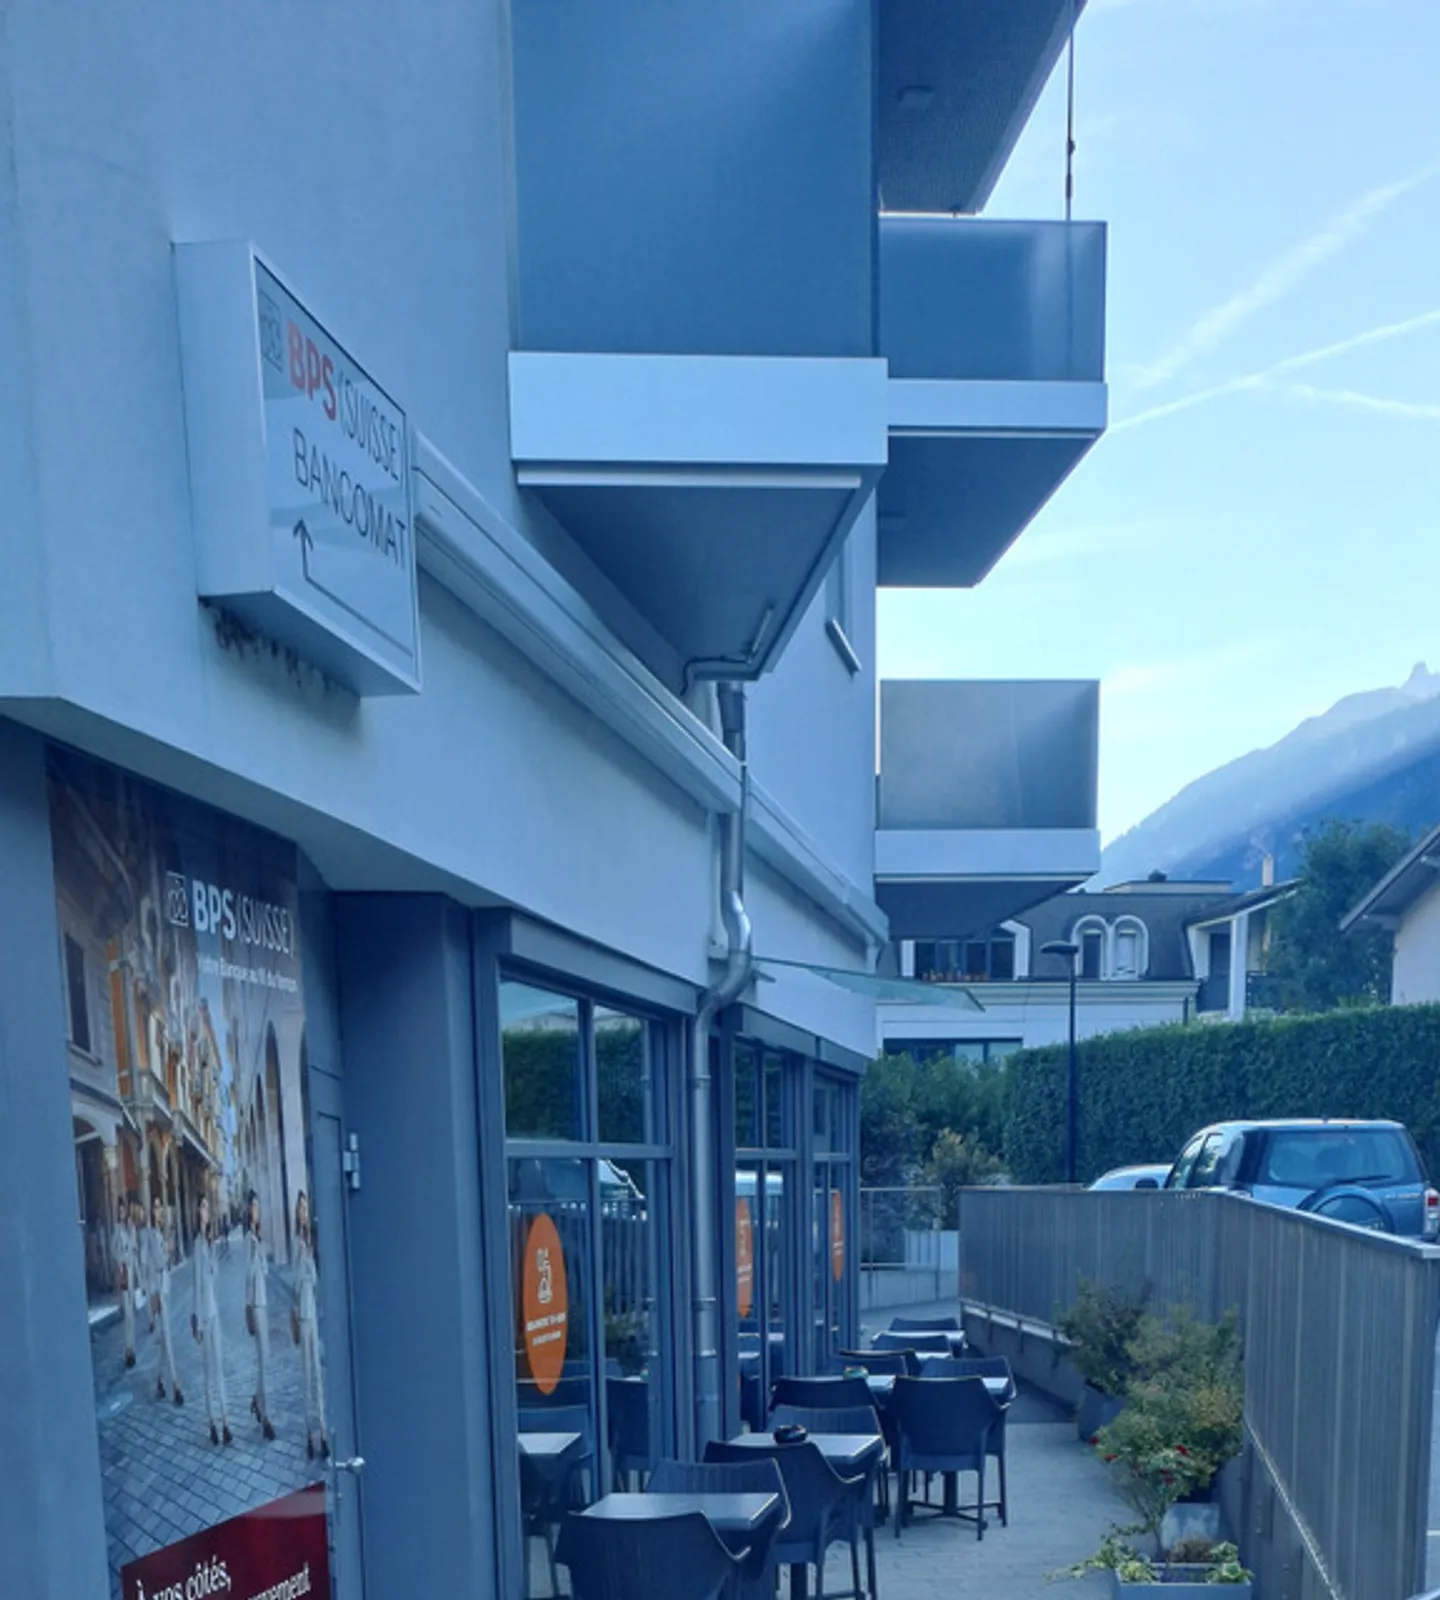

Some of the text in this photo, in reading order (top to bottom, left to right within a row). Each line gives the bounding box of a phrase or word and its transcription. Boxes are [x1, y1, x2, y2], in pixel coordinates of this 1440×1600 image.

[288, 318, 337, 421] BPS
[293, 426, 406, 570] BANCOMAT
[192, 879, 237, 941] BPS
